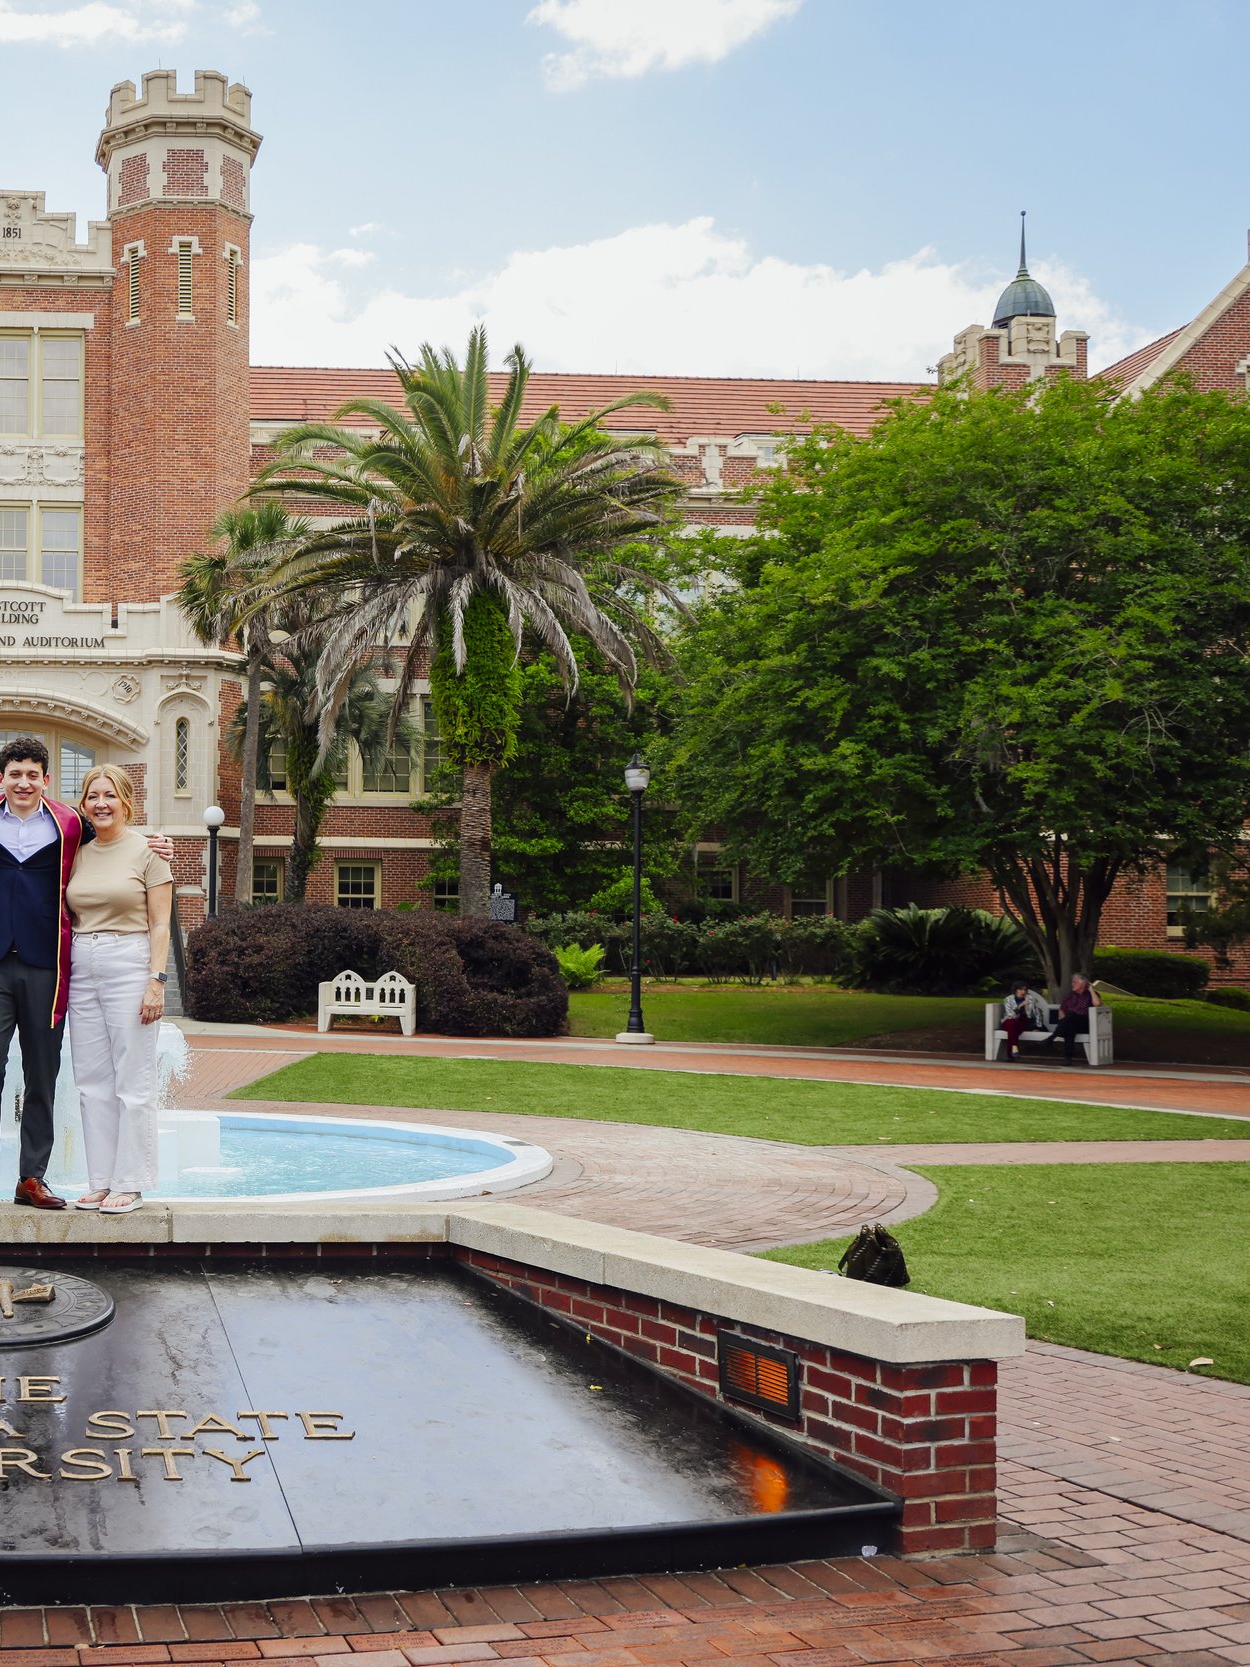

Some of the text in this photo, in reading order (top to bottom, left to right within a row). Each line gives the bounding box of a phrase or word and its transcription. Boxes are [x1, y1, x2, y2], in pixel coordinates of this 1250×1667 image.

[2, 227, 22, 239] 1851
[22, 636, 105, 648] AUDITORIUM
[117, 679, 134, 694] 1910
[84, 1410, 356, 1441] STATE
